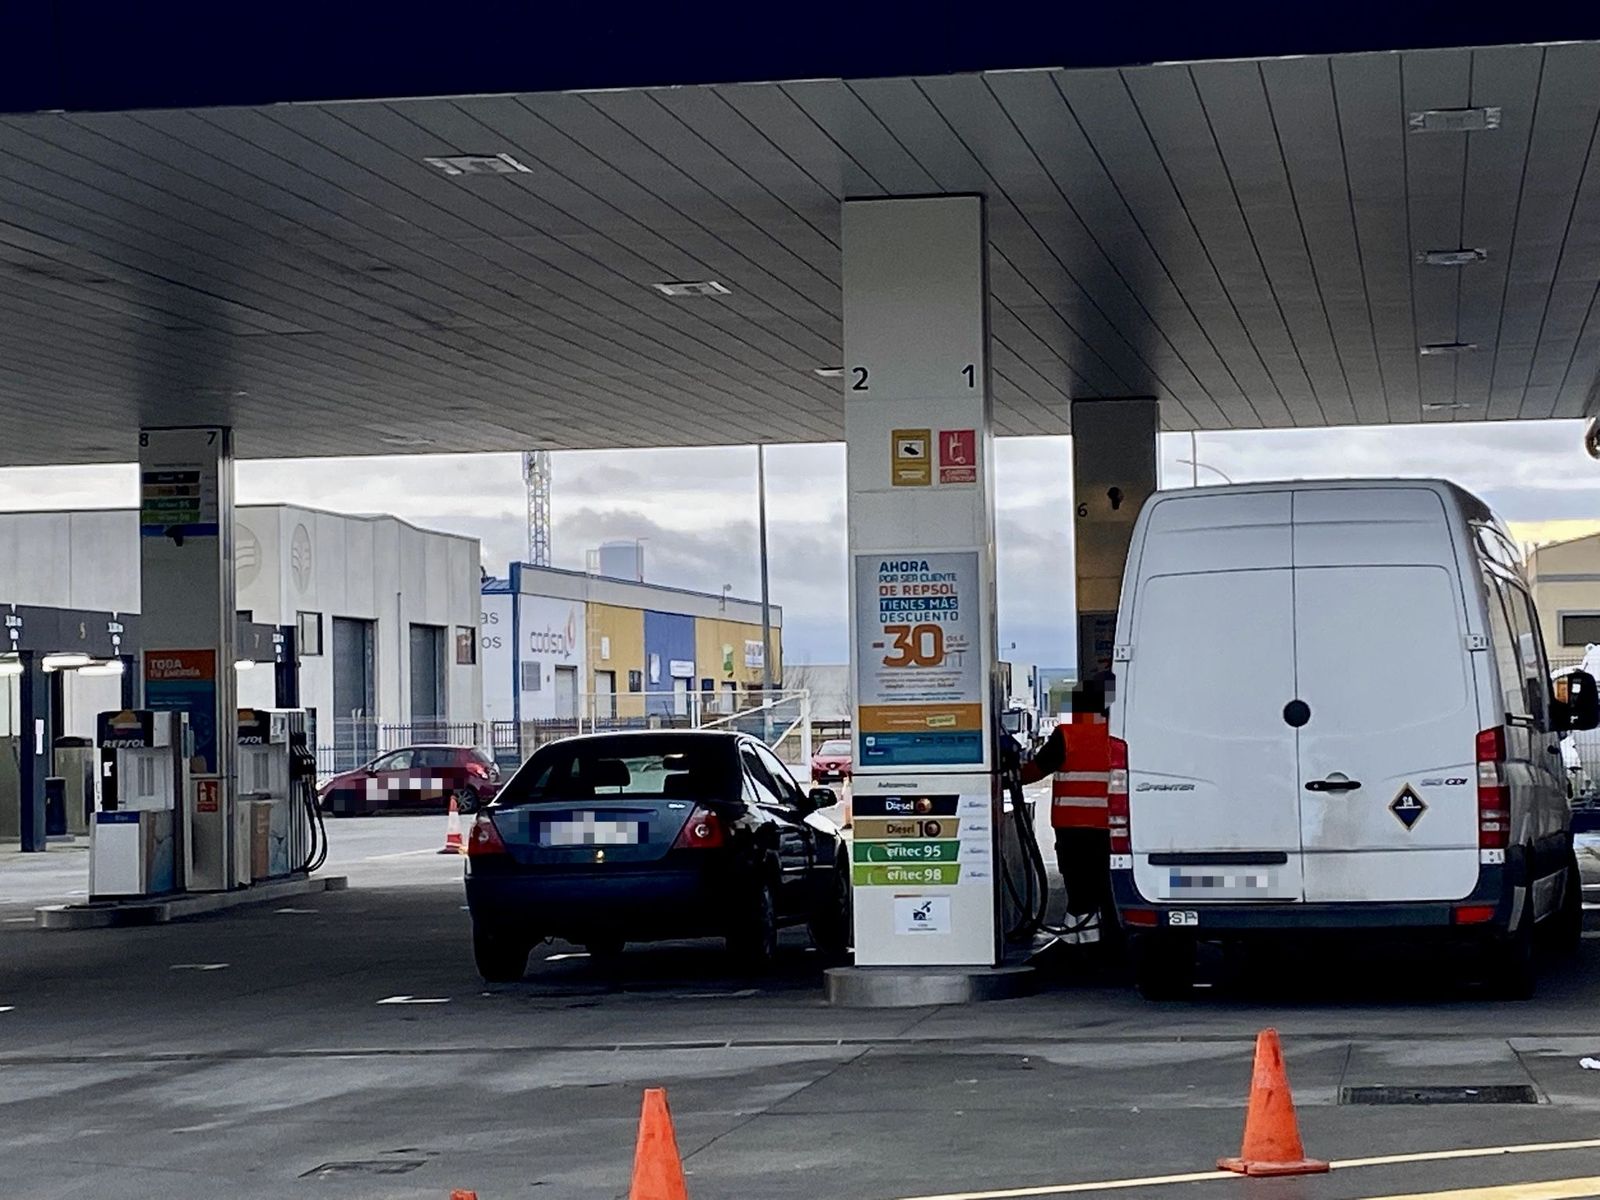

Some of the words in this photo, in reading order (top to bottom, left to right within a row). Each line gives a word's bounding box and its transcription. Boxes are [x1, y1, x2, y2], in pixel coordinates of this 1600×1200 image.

[852, 366, 869, 391] 2
[961, 364, 974, 388] 1
[139, 433, 149, 447] 8
[207, 431, 217, 445] 7
[1077, 502, 1088, 517] 6
[879, 560, 930, 573] AHORA
[879, 573, 899, 583] POR
[900, 573, 919, 583] SER
[879, 585, 898, 597] DE
[902, 583, 958, 595] REPSOL
[880, 599, 926, 611] TIENES
[880, 611, 959, 623] DESCUENTO
[150, 659, 183, 670] TODA
[102, 739, 145, 748] REPSOL
[238, 736, 263, 744] PSOL
[1135, 782, 1196, 792] SPRINTER
[885, 800, 915, 811] Diesel
[886, 823, 915, 835] Diesel
[886, 846, 921, 858] efitec
[923, 845, 942, 857] 95
[887, 869, 922, 881] efitec
[924, 868, 942, 881] 98
